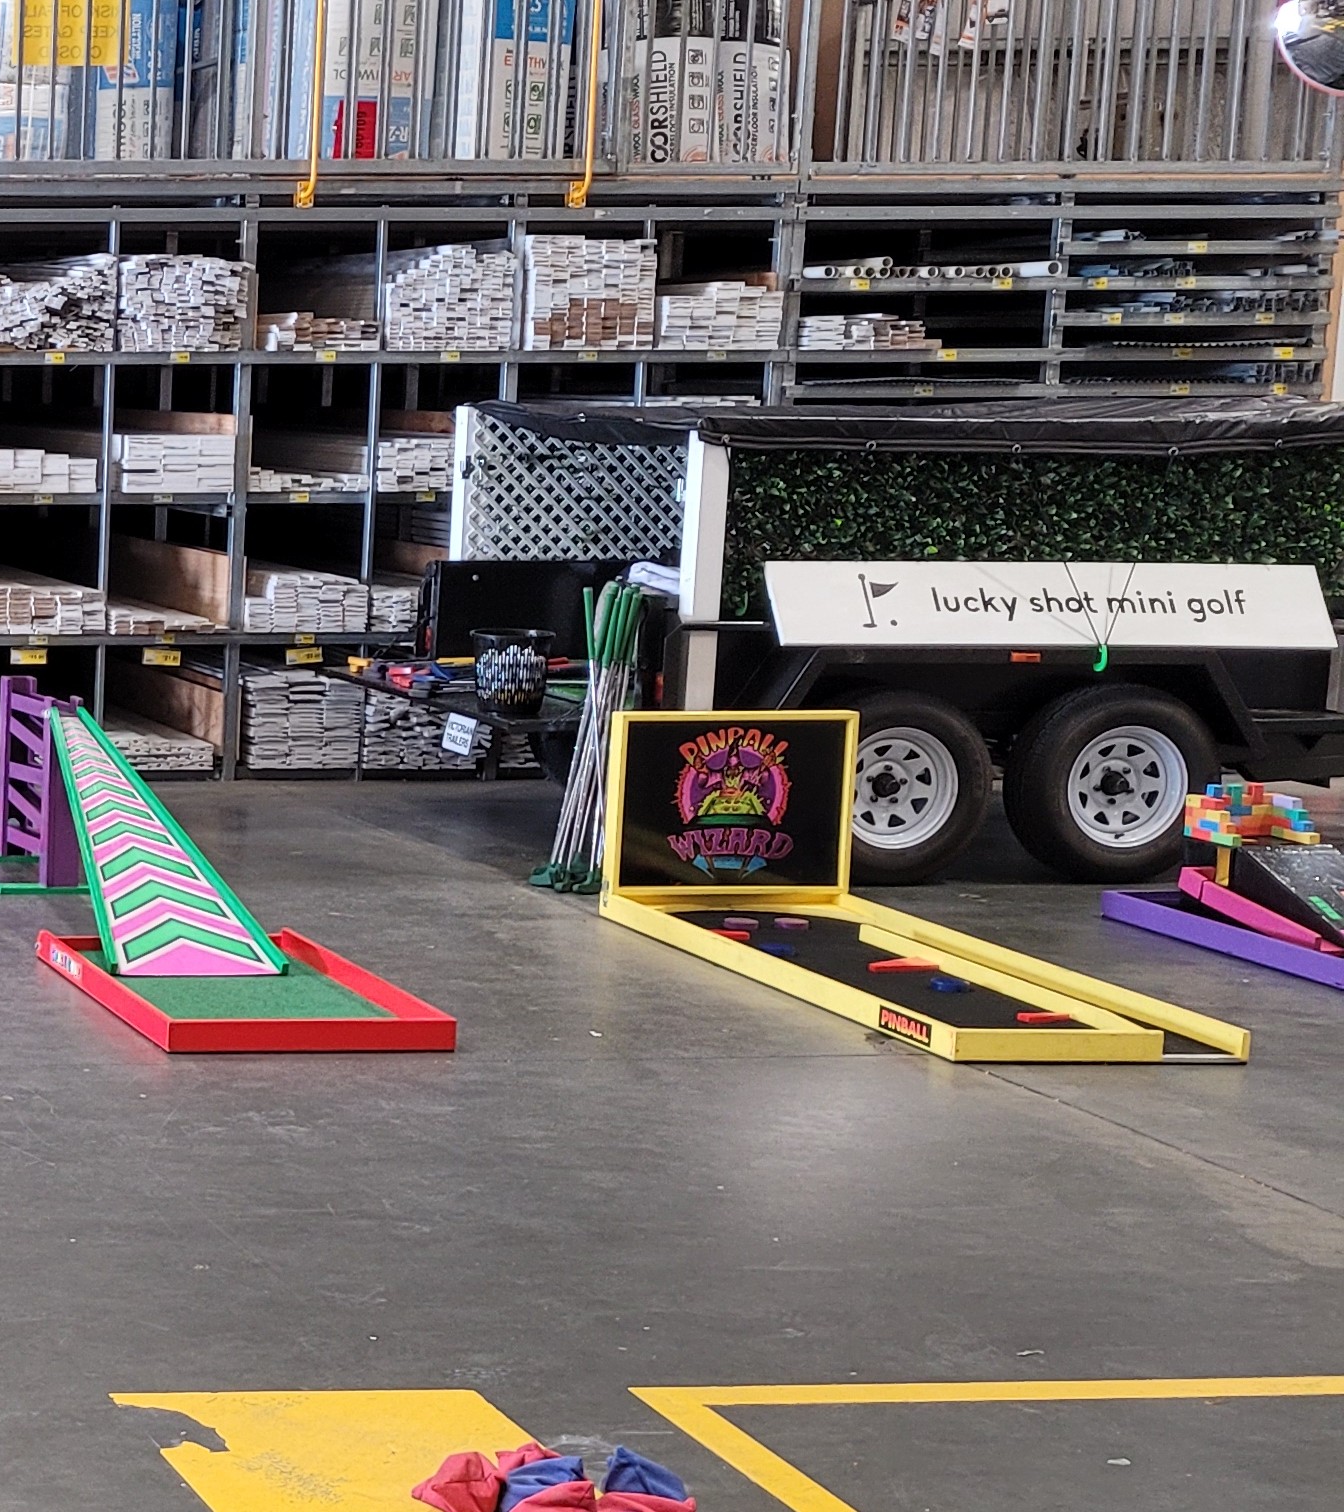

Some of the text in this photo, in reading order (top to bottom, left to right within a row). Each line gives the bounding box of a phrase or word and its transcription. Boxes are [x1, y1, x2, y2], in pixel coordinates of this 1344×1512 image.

[931, 587, 1246, 623] lucky shot mini golf
[678, 727, 789, 766] PINBALL
[666, 827, 794, 862] WIZARD
[880, 1009, 930, 1043] PINBALL
